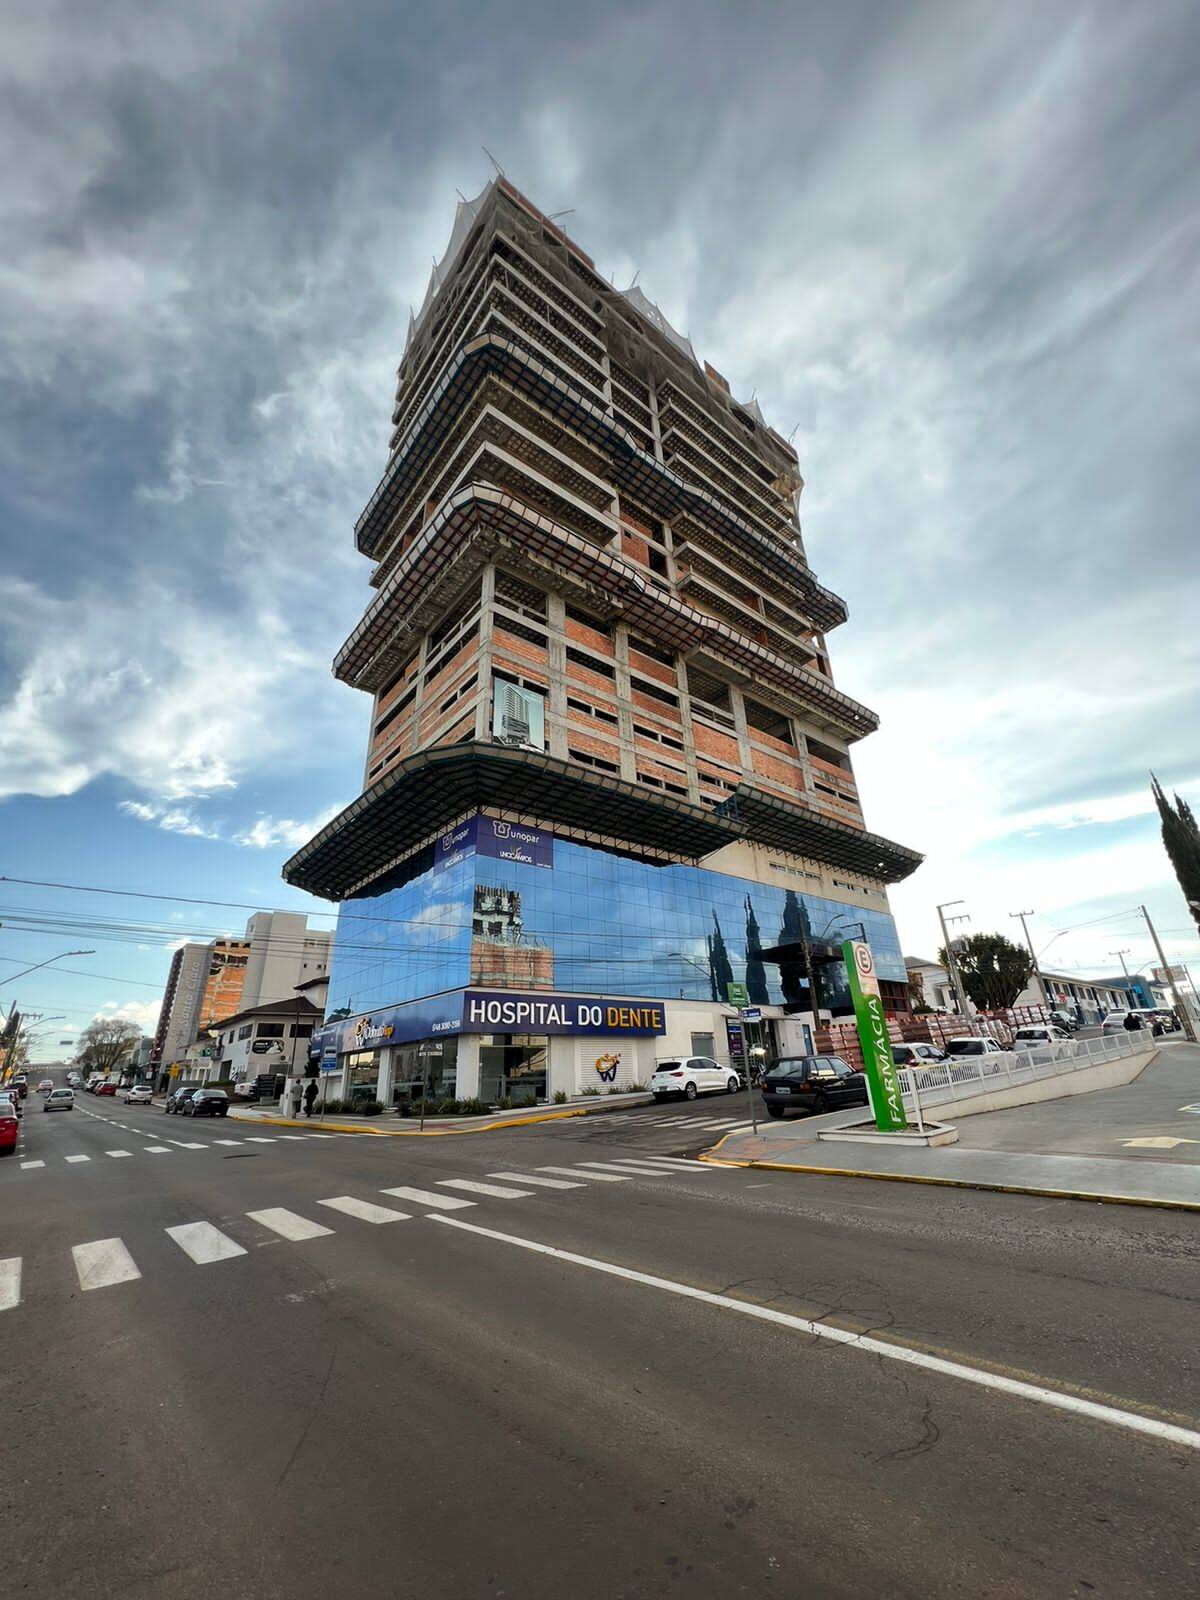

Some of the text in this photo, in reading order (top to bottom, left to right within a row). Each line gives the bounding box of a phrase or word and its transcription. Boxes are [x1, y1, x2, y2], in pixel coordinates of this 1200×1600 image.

[510, 830, 540, 844] unopar
[470, 999, 573, 1026] HOSPITAL
[577, 1004, 602, 1026] DO
[607, 1006, 662, 1028] DENTE
[869, 998, 902, 1124] FARMÁCIA
